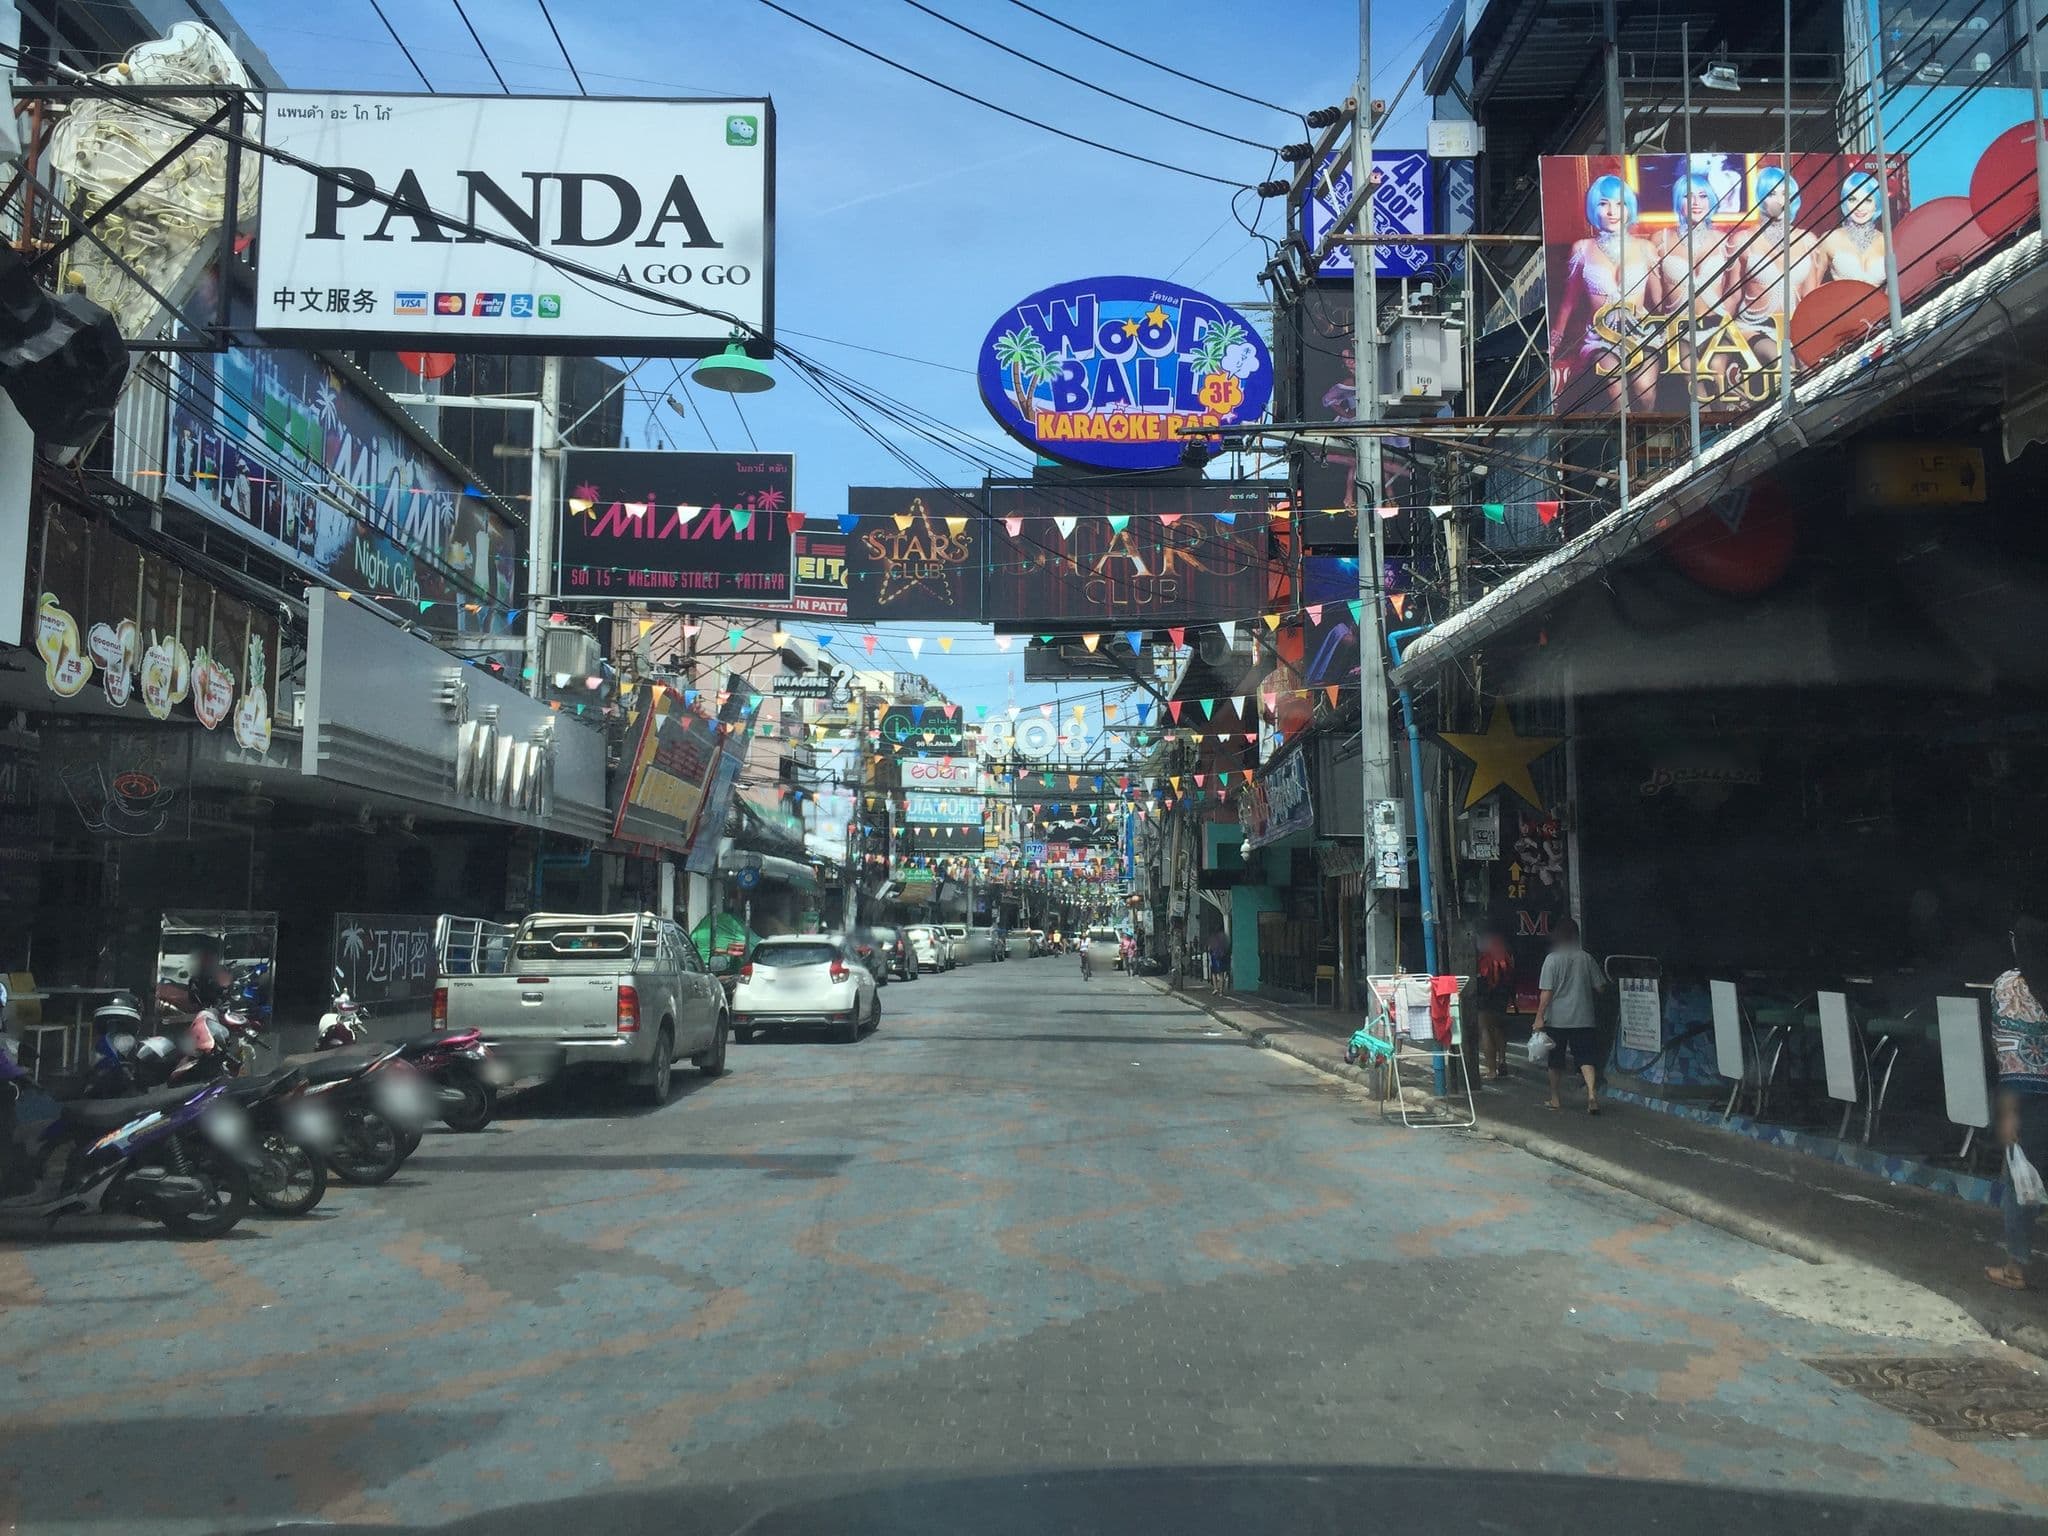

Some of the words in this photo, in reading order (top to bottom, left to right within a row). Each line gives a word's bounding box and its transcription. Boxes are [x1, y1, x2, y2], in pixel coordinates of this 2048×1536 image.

[277, 104, 324, 119] แพนด้า
[330, 108, 348, 120] อะ
[353, 104, 369, 121] โก
[374, 104, 392, 121] โก้
[305, 166, 724, 249] PANDA
[615, 263, 634, 284] A
[642, 263, 693, 285] GO
[701, 264, 751, 285] GO
[273, 286, 378, 314] 中文服务
[400, 299, 421, 308] VISA
[1054, 357, 1210, 413] BALL
[1208, 380, 1234, 404] 3F
[1036, 412, 1161, 441] KARAOKE
[865, 528, 973, 562] STARS
[1000, 509, 1262, 577] STARS
[354, 537, 390, 590] Night
[392, 561, 421, 605] Club
[571, 568, 590, 586] SOI
[596, 569, 611, 586] 15
[681, 571, 720, 589] STREET
[736, 572, 785, 590] PATTAYA
[889, 562, 945, 580] CLUB
[1083, 579, 1180, 605] CLUB
[796, 600, 809, 610] IN
[773, 677, 829, 687] IMAGINE
[1508, 884, 1527, 898] 2F
[367, 927, 429, 982] 迈阿密
